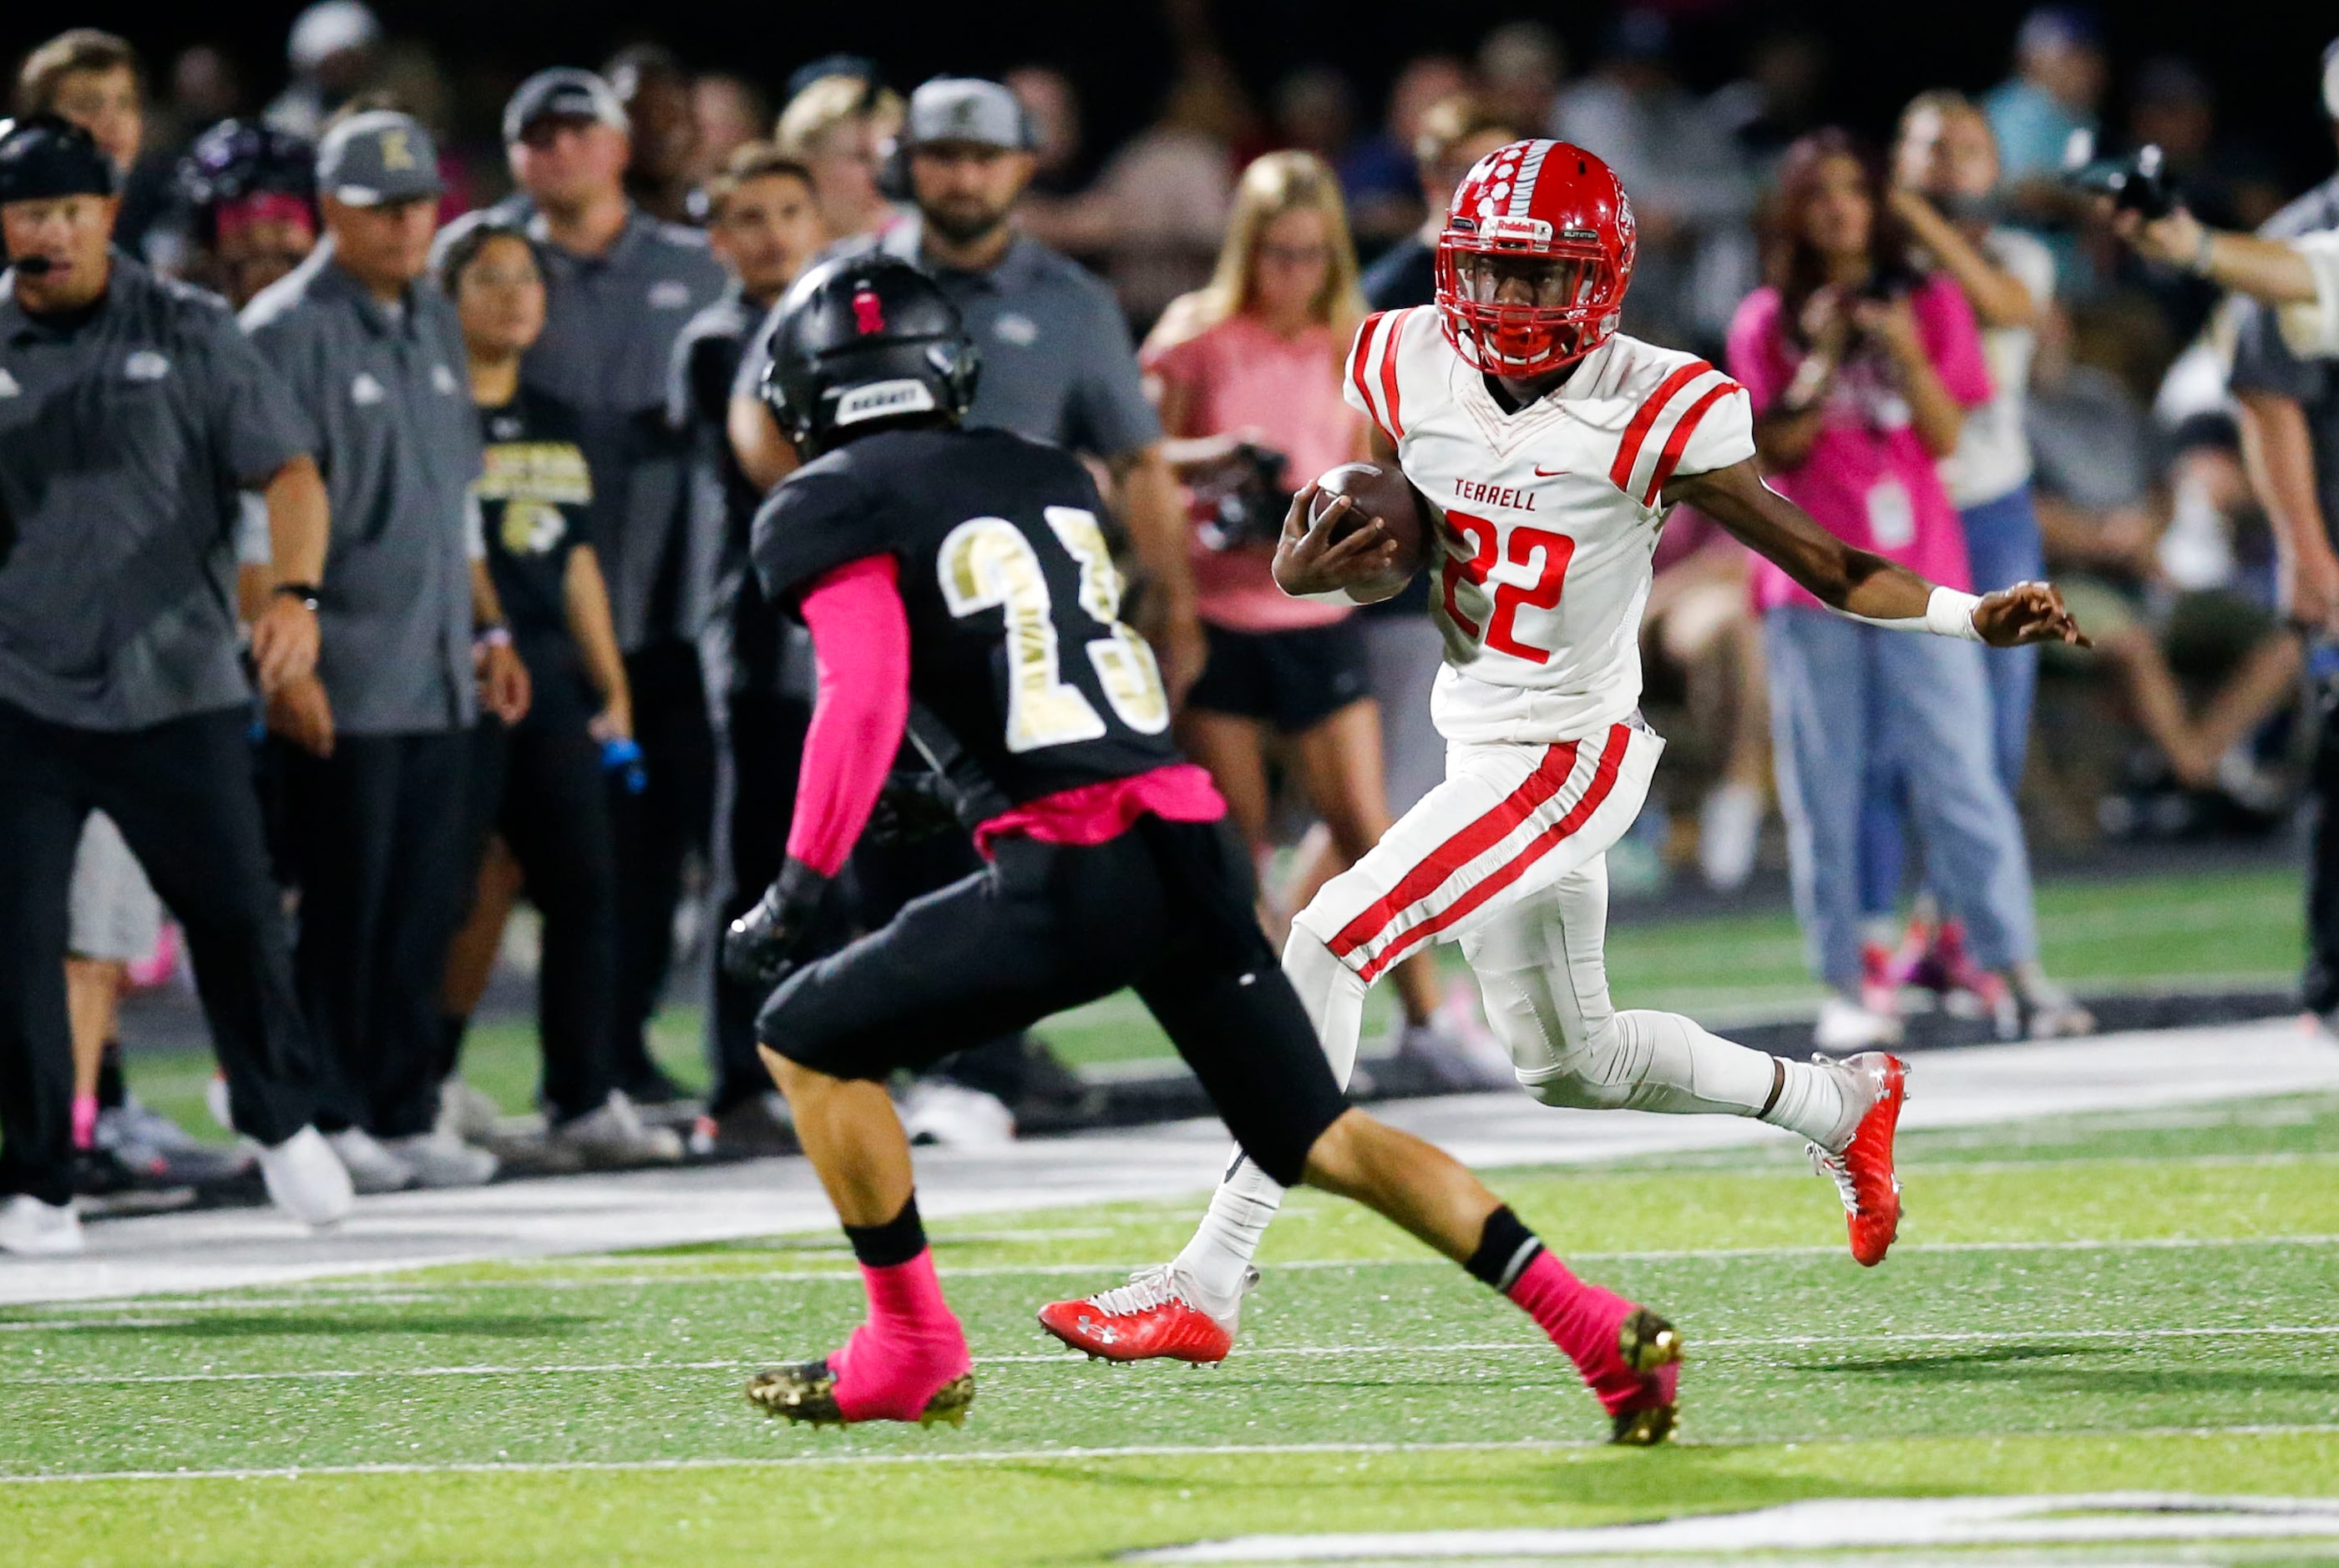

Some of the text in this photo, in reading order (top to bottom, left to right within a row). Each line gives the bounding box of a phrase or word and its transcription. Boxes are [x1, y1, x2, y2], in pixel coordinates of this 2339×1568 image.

[1497, 220, 1536, 234] Riddell
[1456, 478, 1536, 512] TERRELL
[936, 505, 1171, 754] 23
[1441, 508, 1576, 665] 22
